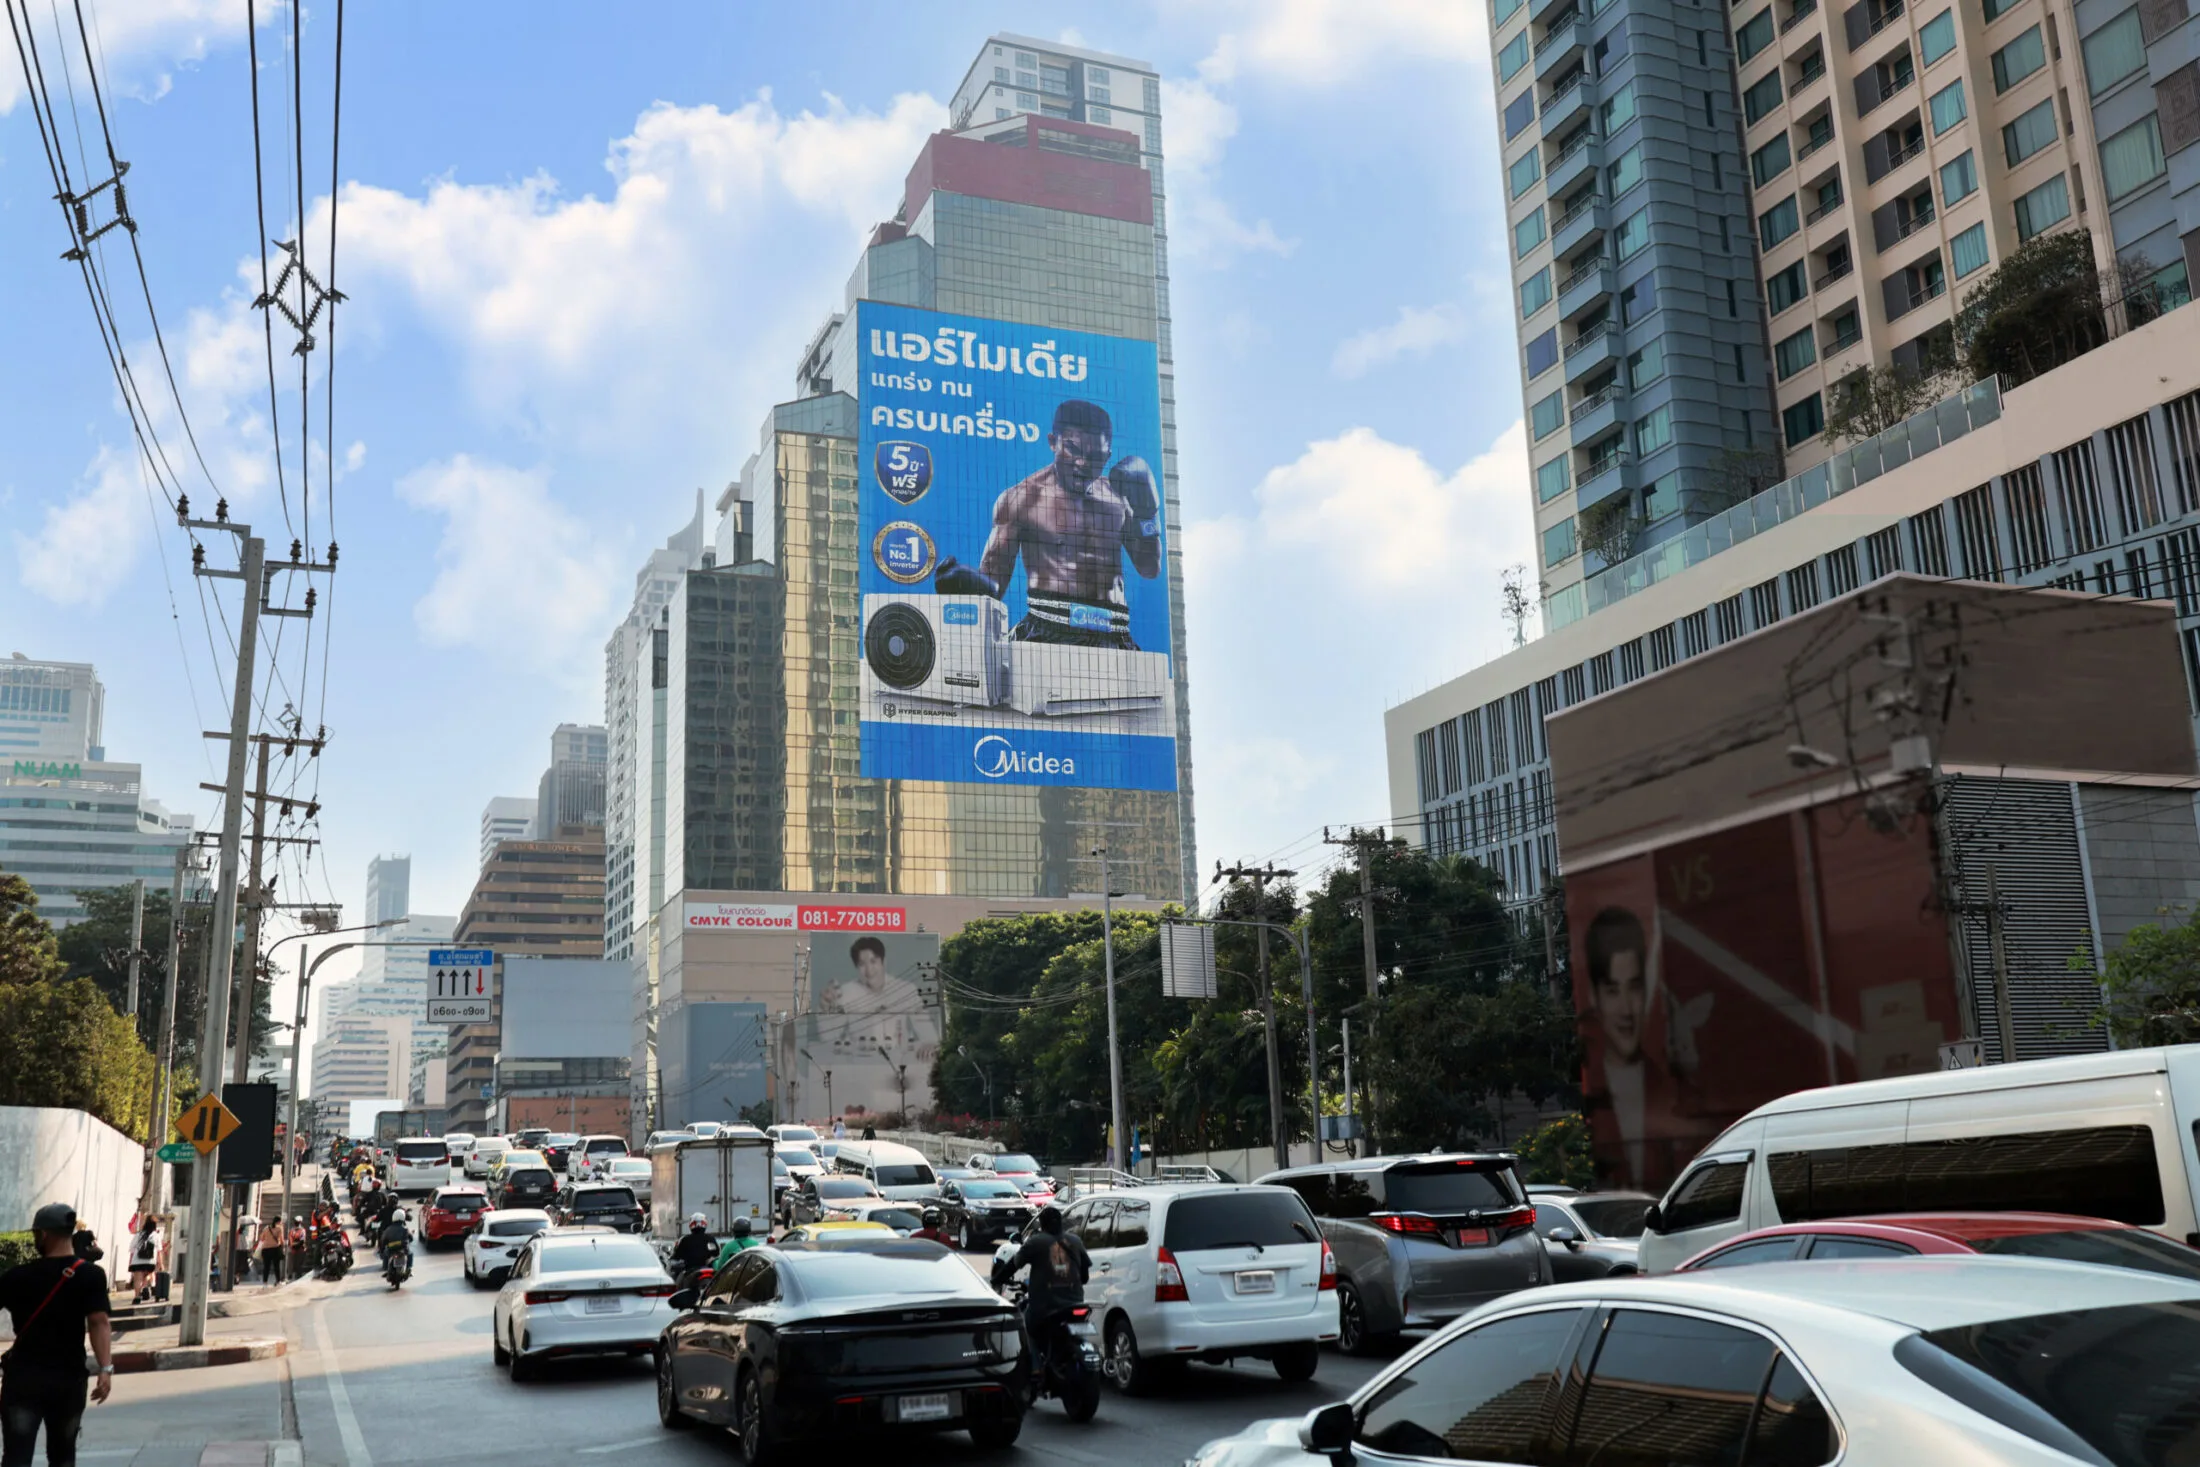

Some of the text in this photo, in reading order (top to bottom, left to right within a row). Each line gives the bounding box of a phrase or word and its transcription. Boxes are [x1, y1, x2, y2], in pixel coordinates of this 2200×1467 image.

[871, 327, 1088, 382] แอร์ไมเดีย
[871, 371, 972, 398] แกร่ง ทน
[871, 402, 1040, 443] ครบเครื่อง
[892, 473, 918, 489] ฟรี
[946, 607, 975, 621] Midea
[974, 735, 1075, 778] Midea
[1669, 852, 1715, 903] VS
[689, 911, 901, 927] CMYK COLOUR 081-7708518
